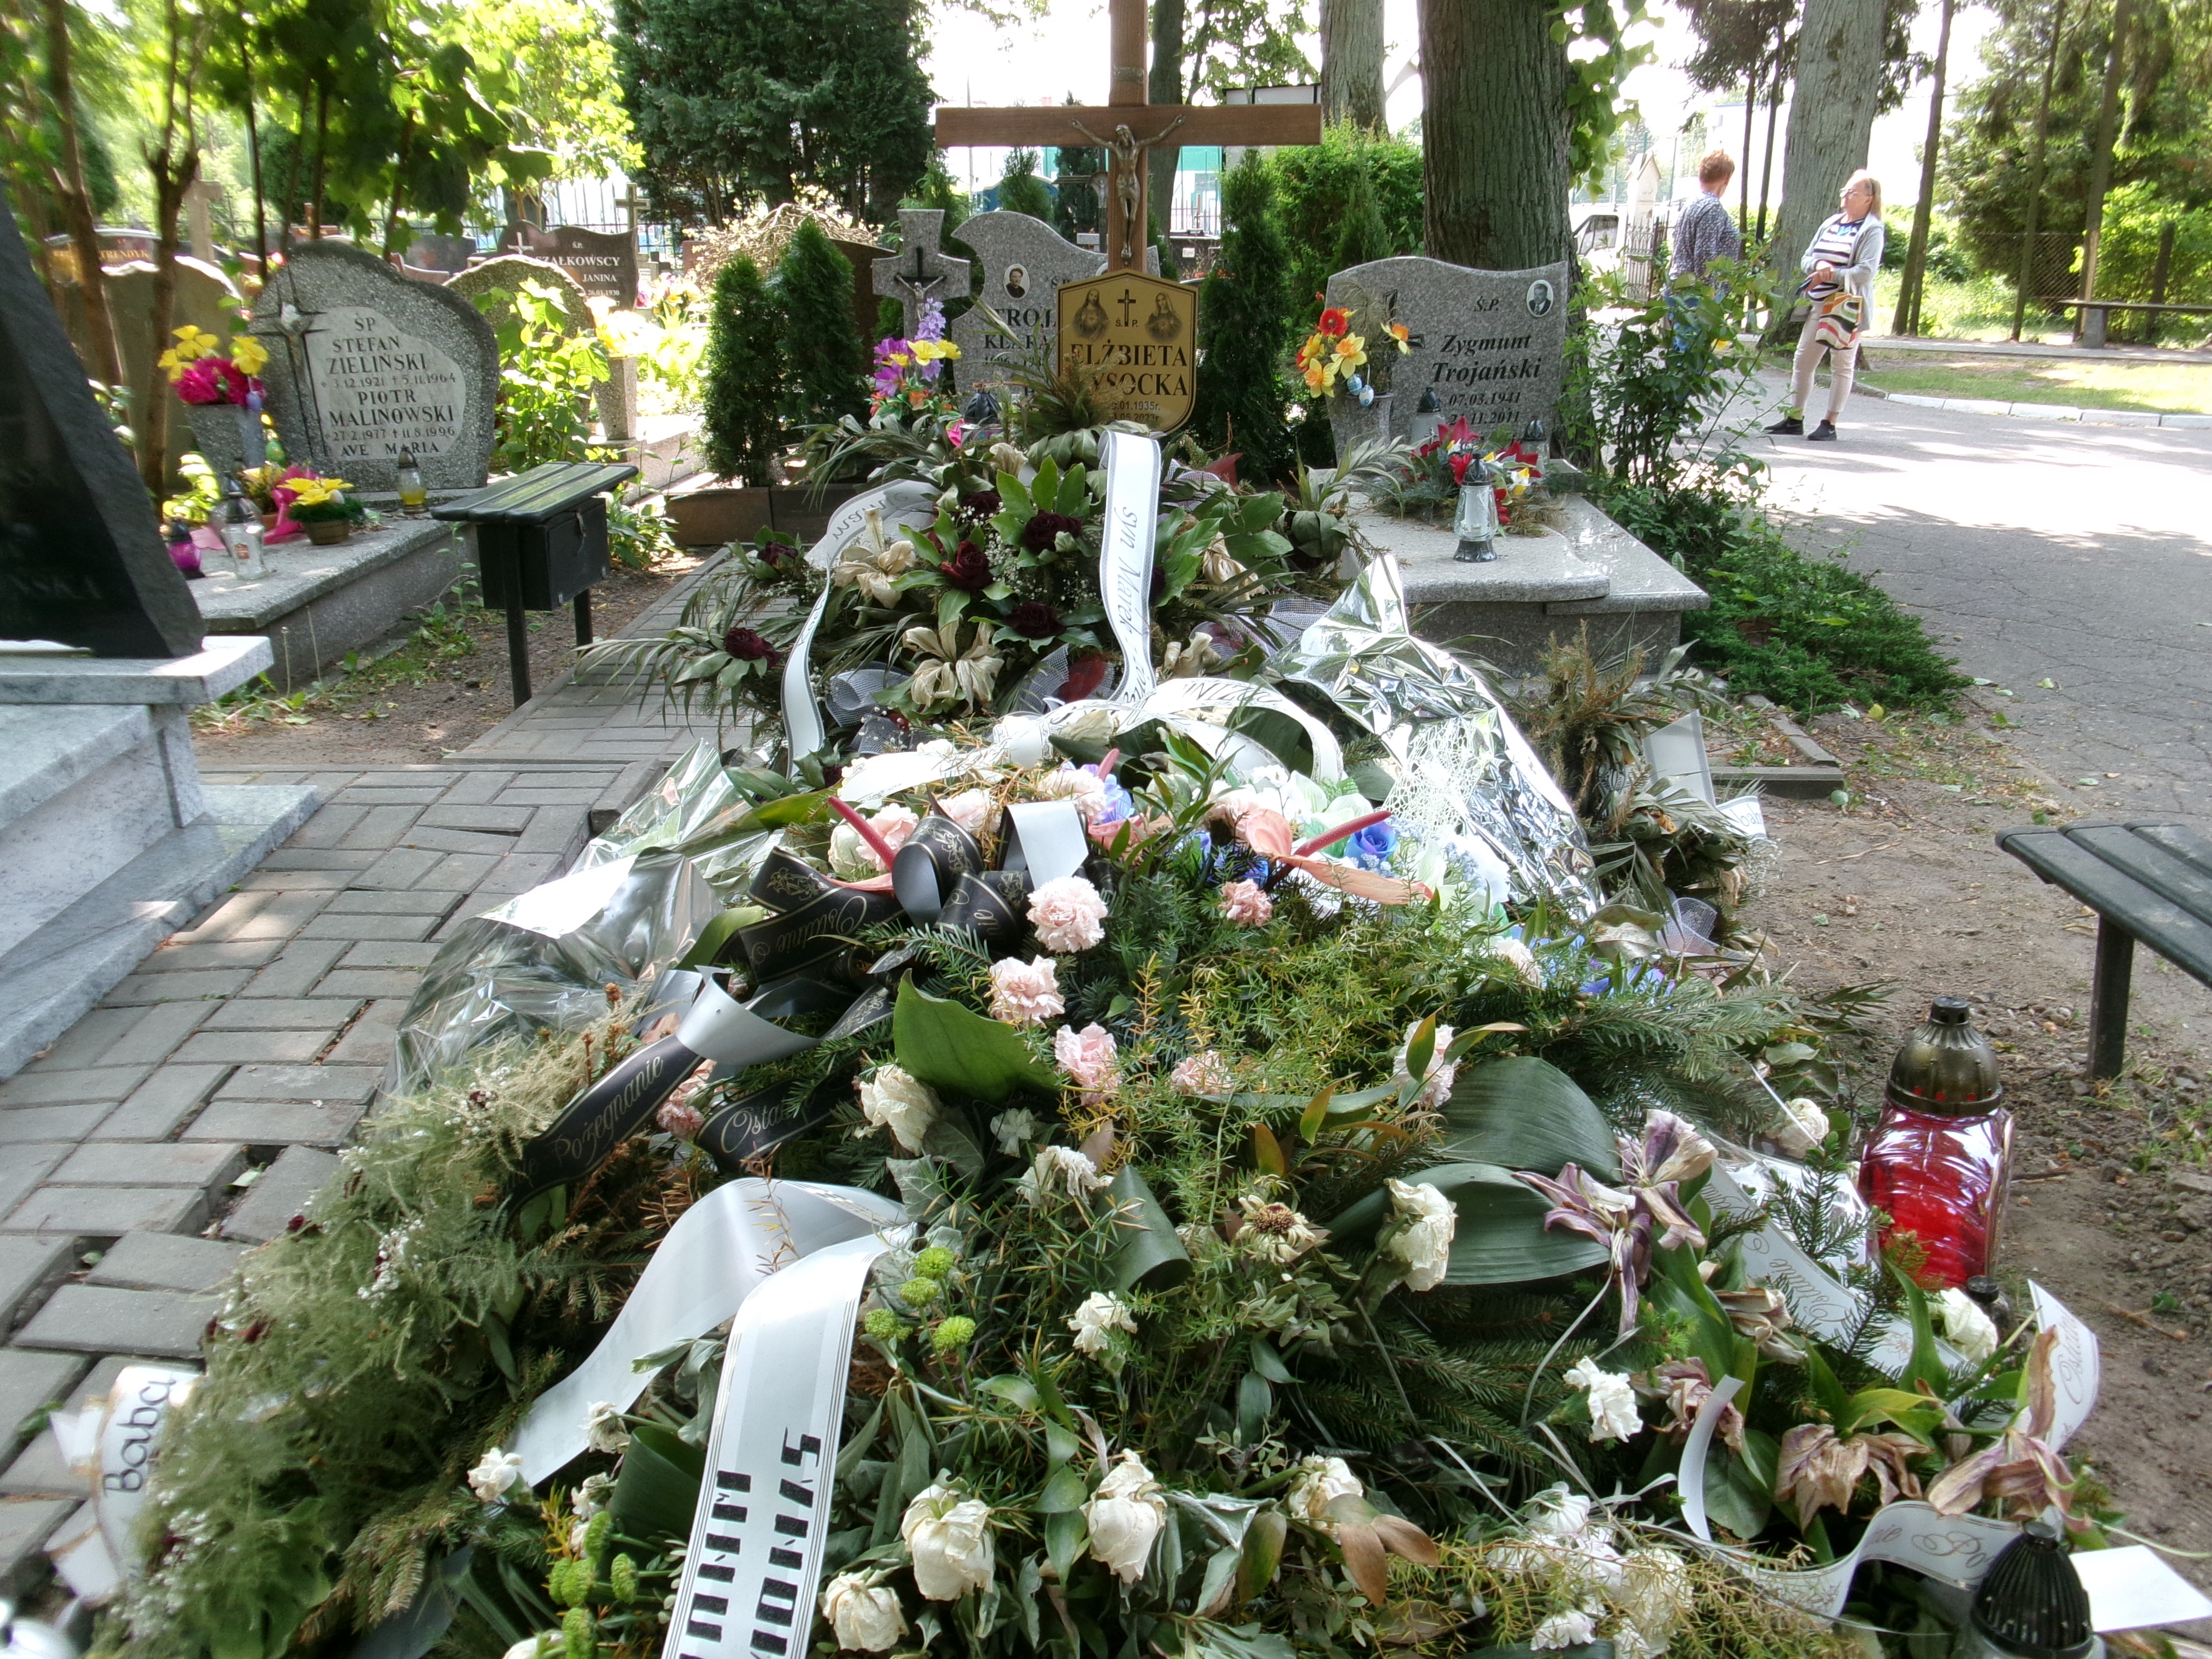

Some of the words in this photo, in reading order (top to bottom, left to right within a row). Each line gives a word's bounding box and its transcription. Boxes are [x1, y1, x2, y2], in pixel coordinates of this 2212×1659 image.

[582, 274, 617, 282] JANINA
[1474, 296, 1499, 312] Ś.P.
[994, 308, 1057, 327] TROJ
[332, 336, 400, 353] STEFAN
[1070, 338, 1188, 366] ELŻBIETA
[1440, 334, 1532, 357] Zygmunt
[326, 353, 427, 375] ZIELIŃSKI
[1431, 357, 1542, 387] Trojański
[1089, 373, 1188, 396] YSOCKA
[357, 389, 417, 405] PIOTR
[1449, 391, 1521, 407] 07.03.1941
[329, 405, 454, 427] MALINOWSKI
[341, 444, 369, 456] AVE
[384, 441, 440, 455] MARIA
[1114, 506, 1138, 549] syn
[1117, 556, 1143, 636] Marek
[546, 1056, 664, 1166] Pożegnanie
